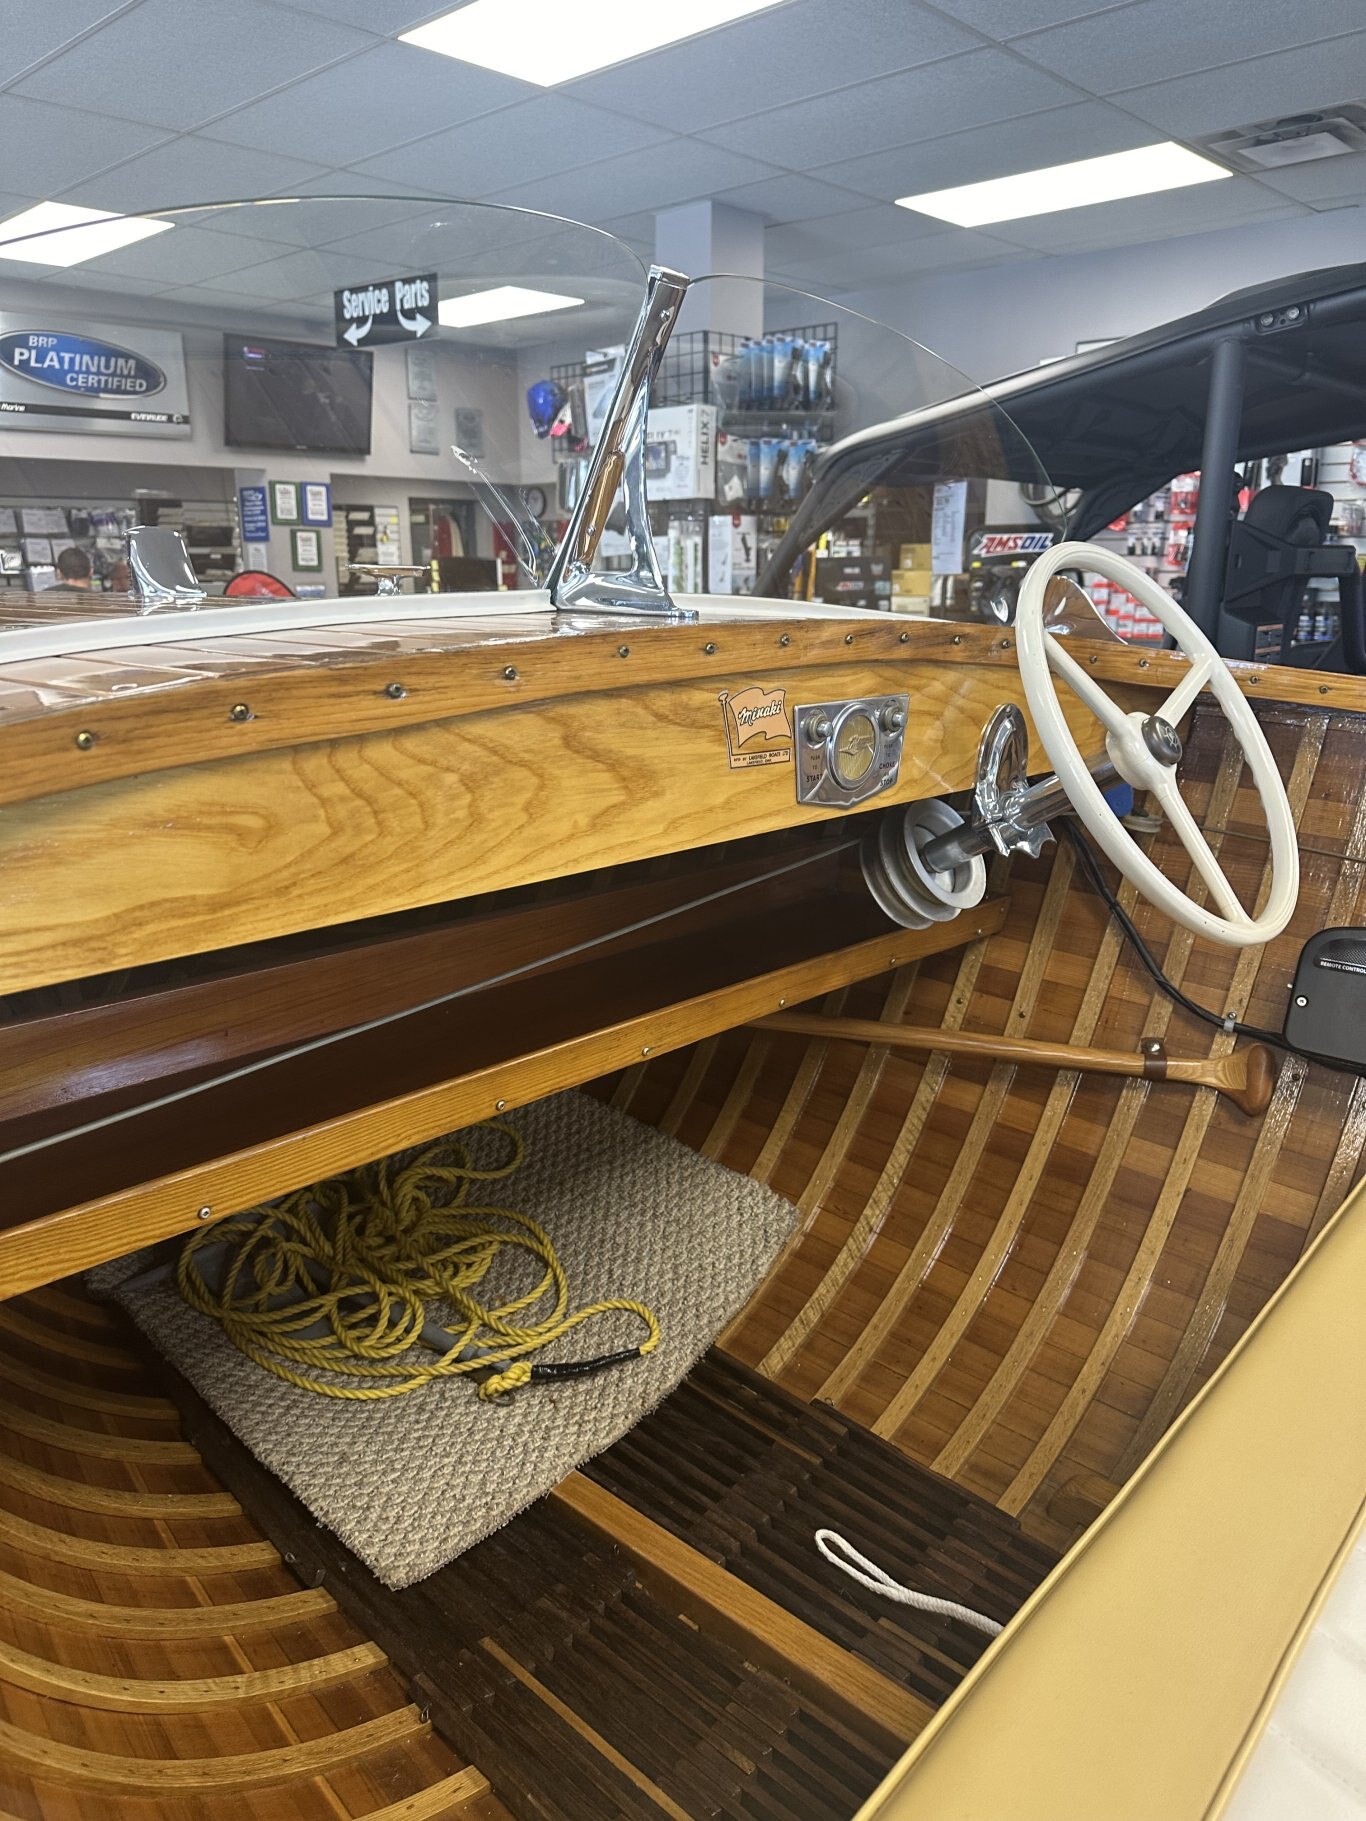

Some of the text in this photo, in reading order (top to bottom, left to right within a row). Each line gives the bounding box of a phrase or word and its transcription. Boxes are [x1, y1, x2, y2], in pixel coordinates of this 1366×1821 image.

[342, 279, 430, 319] Service Parts
[28, 335, 58, 348] BRP
[13, 348, 137, 376] PLATINUM
[66, 373, 147, 392] CERTIFIED
[701, 421, 709, 466] HELIX
[979, 535, 1050, 555] AMSOIL
[738, 700, 782, 726] Minaki
[806, 774, 823, 783] START
[1320, 961, 1341, 969] REMOTE
